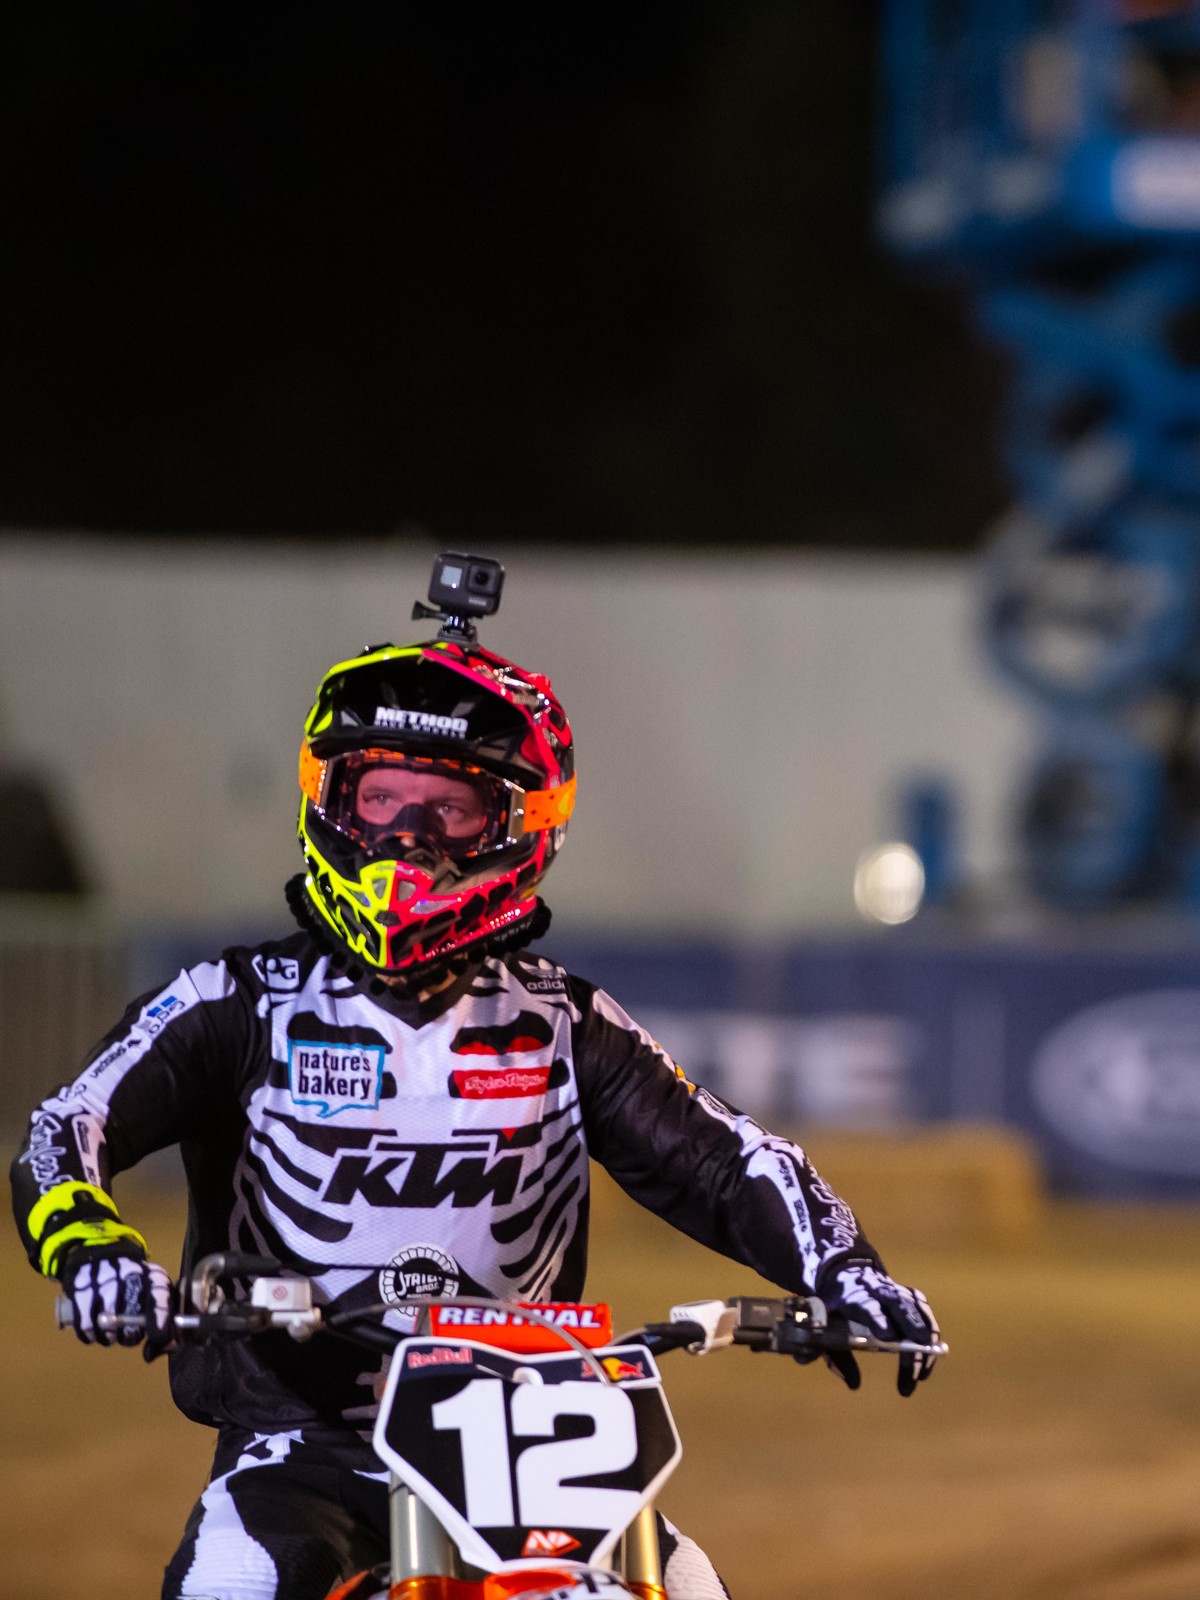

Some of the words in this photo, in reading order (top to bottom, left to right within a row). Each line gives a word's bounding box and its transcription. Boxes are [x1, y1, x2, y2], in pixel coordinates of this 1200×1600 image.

[376, 706, 468, 733] METHOD
[299, 1048, 371, 1073] nature's
[298, 1071, 372, 1099] bakery
[322, 1142, 524, 1208] KTM
[408, 1347, 439, 1368] Red
[439, 1346, 473, 1365] Bull
[432, 1378, 643, 1530] 12
